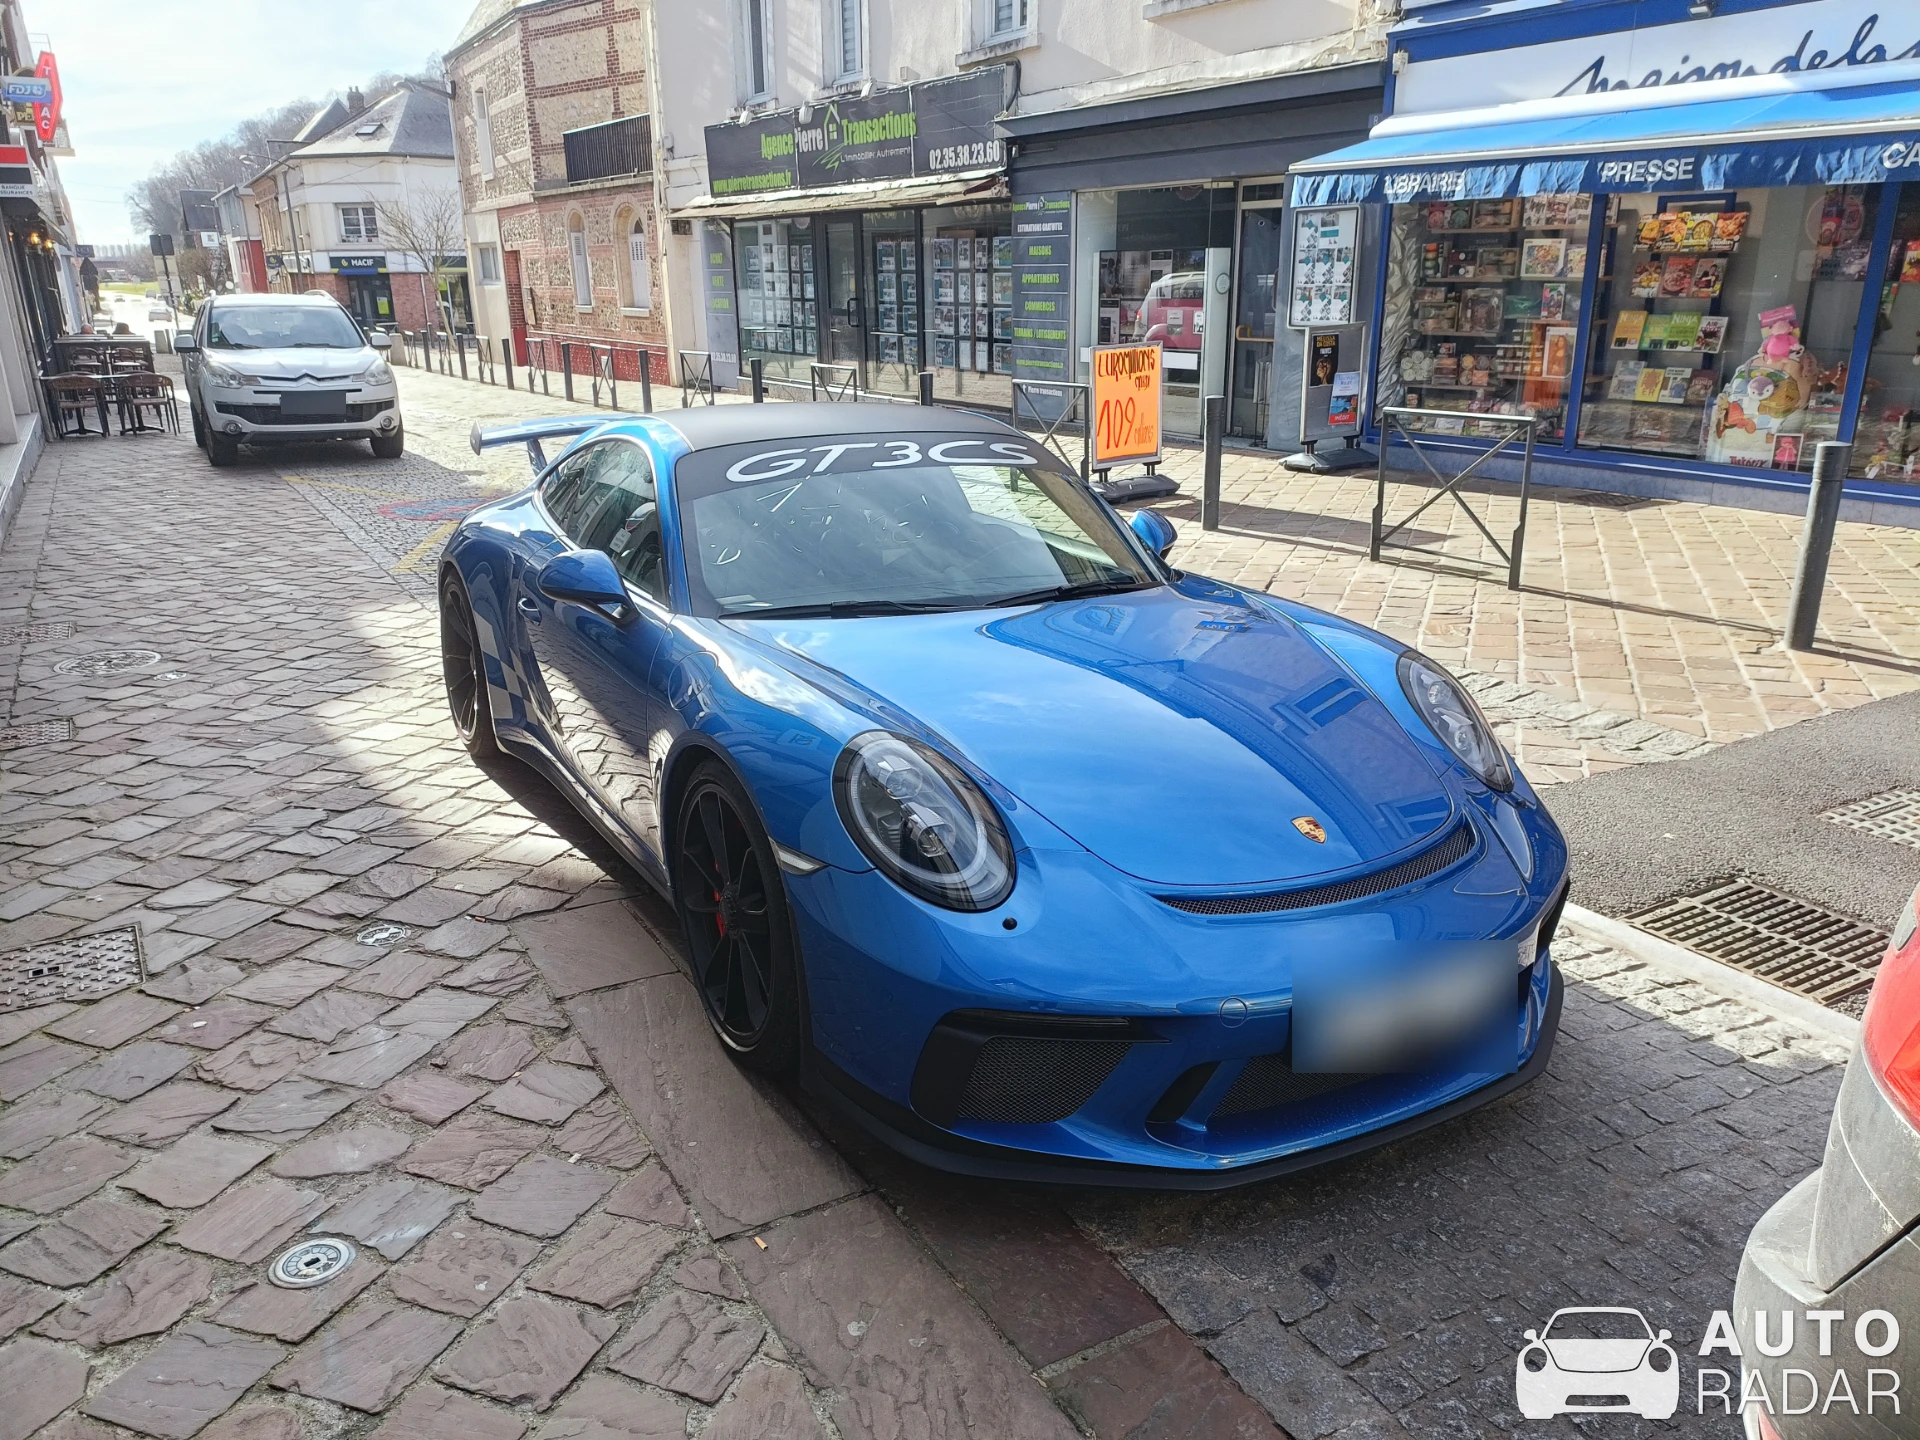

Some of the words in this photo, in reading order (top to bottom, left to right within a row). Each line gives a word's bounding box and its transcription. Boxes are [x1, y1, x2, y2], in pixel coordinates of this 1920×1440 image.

[8, 84, 31, 95] FDJ
[761, 133, 794, 160] Agence
[795, 127, 823, 153] Pierre
[841, 111, 917, 146] Transactions
[929, 140, 1000, 170] 02.35.38.23.60
[1600, 157, 1695, 183] PRESSE
[1384, 170, 1464, 194] LIBRAIRIE
[1029, 245, 1052, 256] MAISONS
[351, 258, 374, 266] MACIF
[1021, 273, 1060, 284] APPARTEMENTS
[1025, 301, 1055, 311] COMMERCES
[1096, 396, 1136, 450] 109
